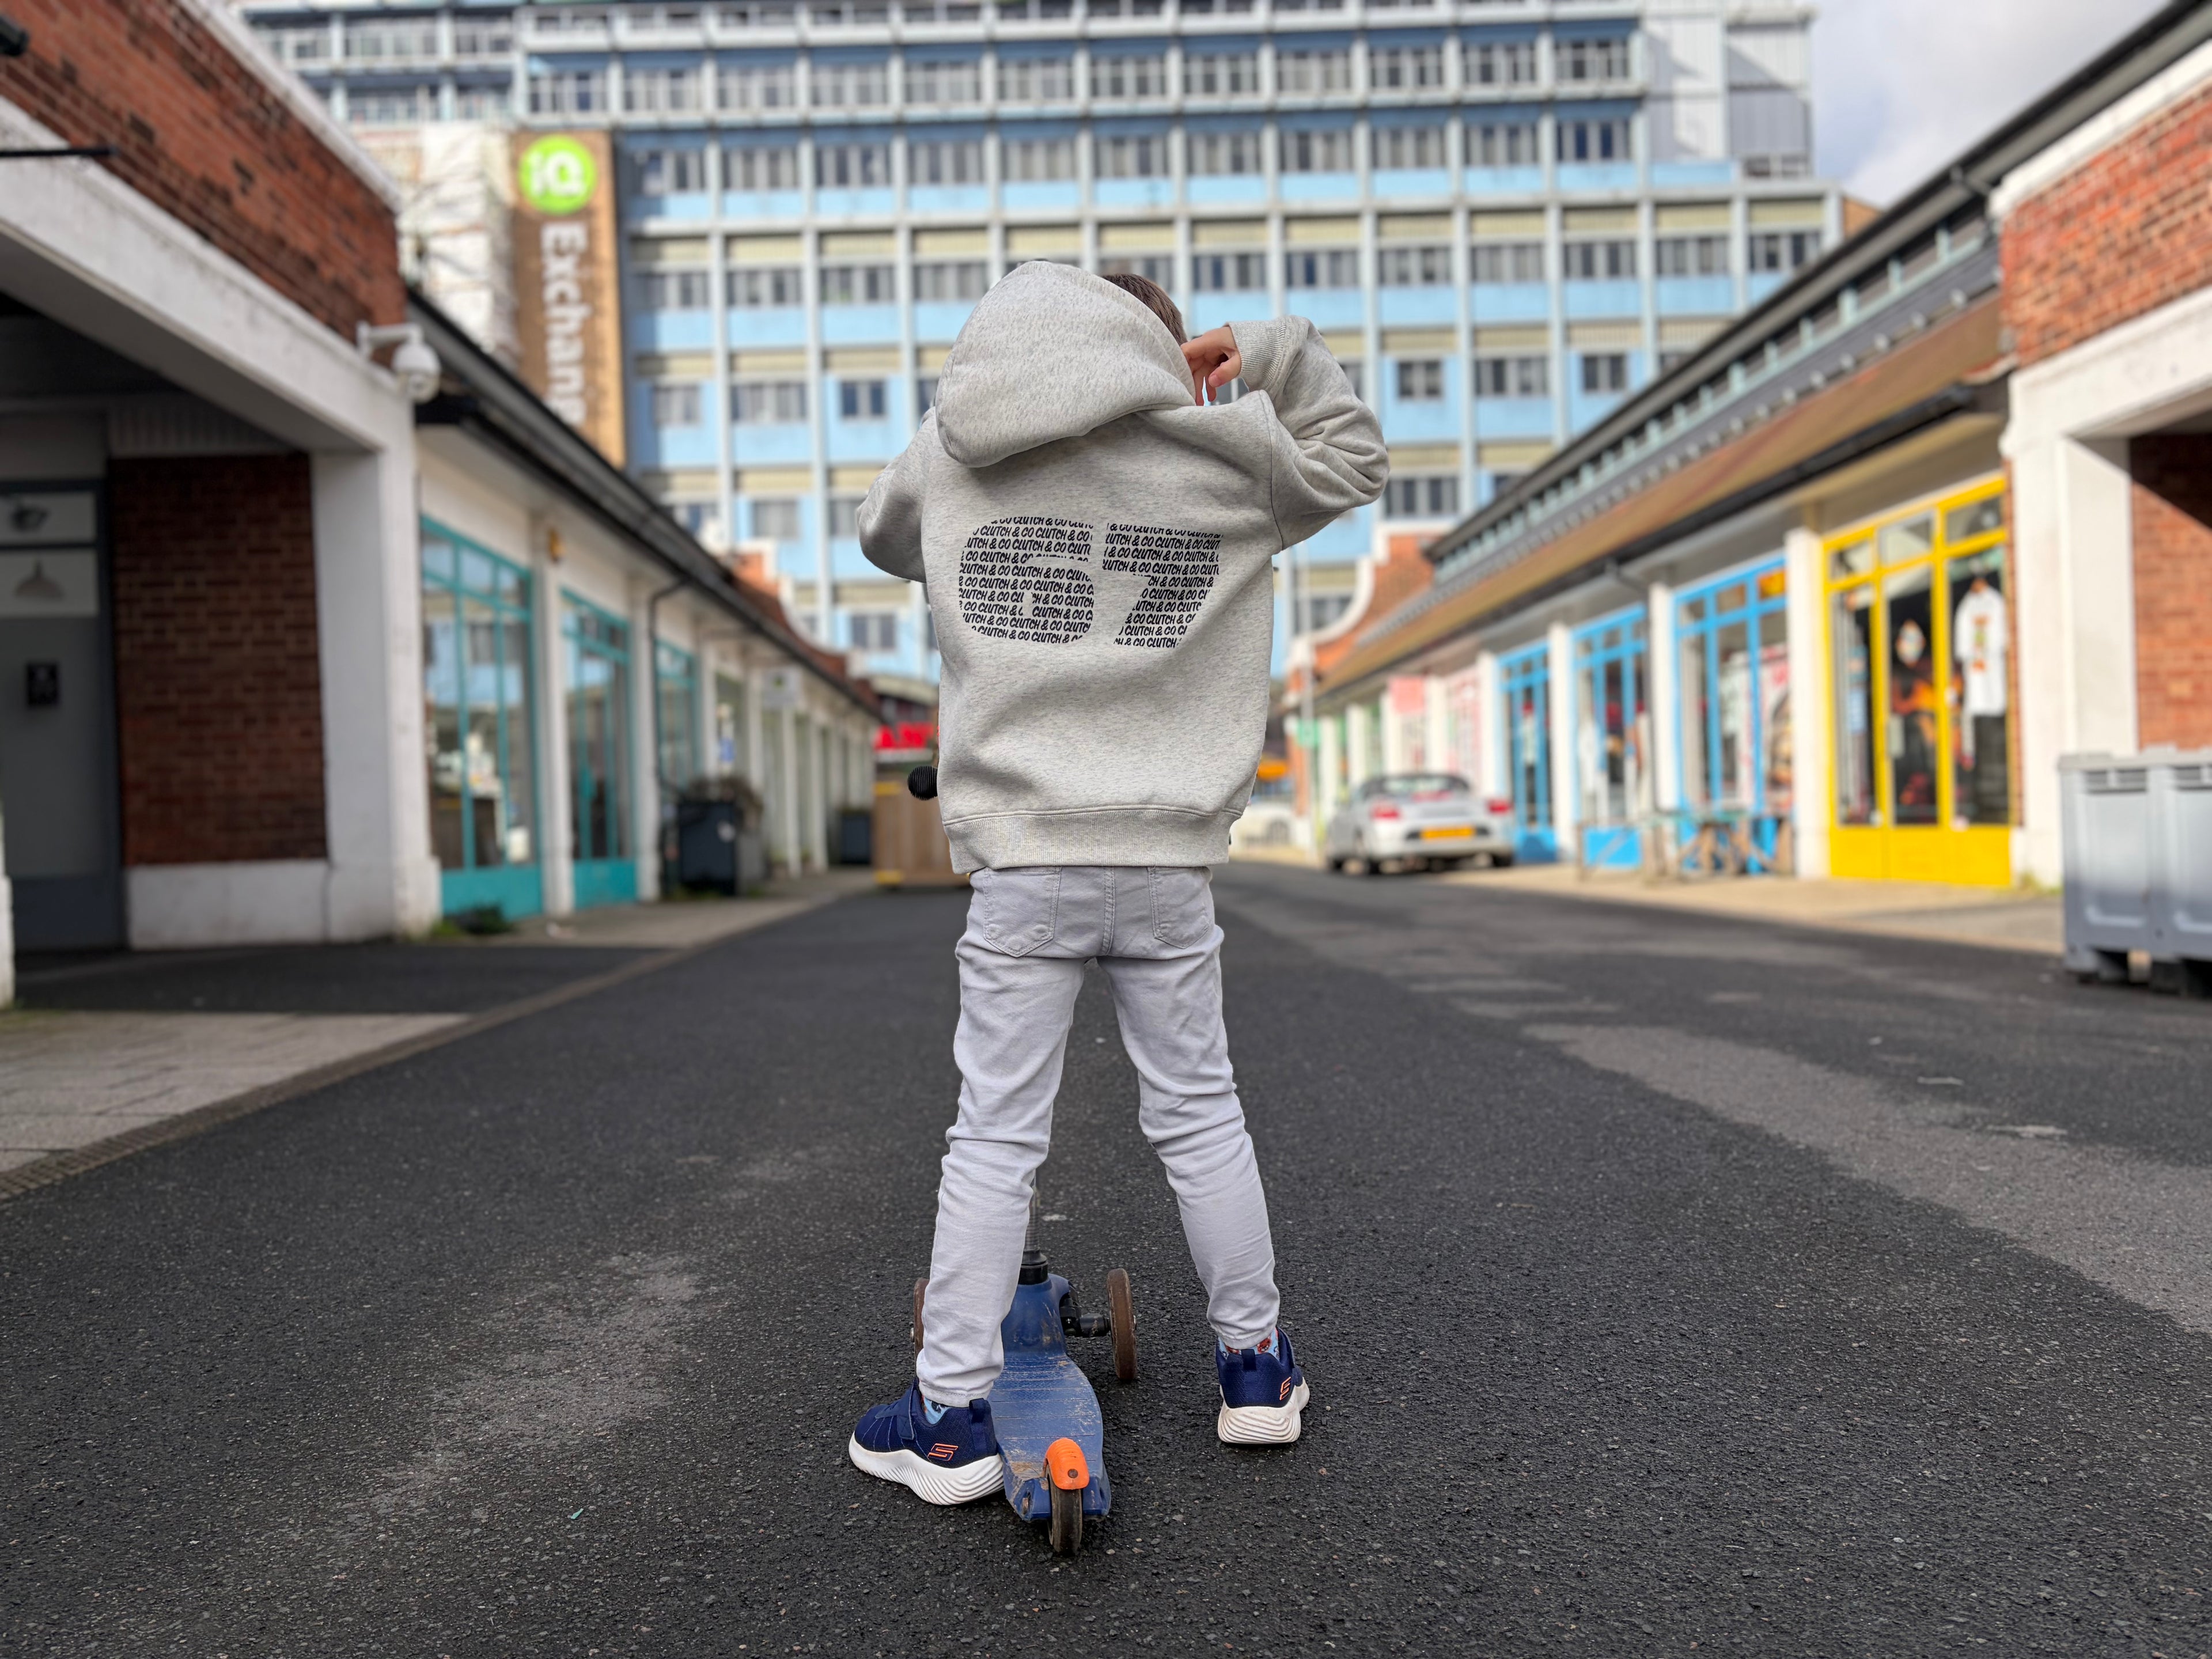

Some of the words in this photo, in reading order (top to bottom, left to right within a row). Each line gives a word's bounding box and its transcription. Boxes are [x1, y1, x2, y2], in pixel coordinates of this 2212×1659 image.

[980, 525, 1013, 537] CLUTCH
[1012, 526, 1020, 538] &
[1021, 527, 1035, 538] CO
[1035, 527, 1068, 541] CLUTCH
[1067, 529, 1076, 541] &
[1076, 530, 1090, 543] CO
[1105, 532, 1132, 546] LUTCH
[1131, 535, 1141, 547] &
[1141, 535, 1154, 547] CO
[1154, 536, 1186, 550] CLUTCH
[1184, 538, 1192, 550] &
[1191, 539, 1204, 550] CO
[964, 537, 990, 550] UTCH
[988, 537, 997, 550] &
[998, 538, 1012, 550] CO
[1012, 538, 1045, 552] CLUTCH
[1044, 540, 1053, 552] &
[1053, 541, 1067, 554] CO
[965, 550, 979, 562] CO
[979, 551, 1012, 564] CLUTCH
[1010, 552, 1020, 565] &
[1108, 546, 1117, 558] &
[1117, 547, 1131, 559] CO
[1131, 547, 1164, 562] CLUTCH
[1162, 550, 1171, 562] &
[1171, 550, 1184, 562] CO
[1184, 550, 1210, 563] CLUTCH
[1208, 551, 1215, 563] &
[988, 564, 997, 576] &
[997, 565, 1011, 577] CO
[1011, 565, 1044, 579] CLUTCH
[1043, 567, 1052, 579] &
[1052, 567, 1066, 580] CO
[1102, 559, 1130, 572] LUTCH
[1128, 560, 1138, 573] &
[1138, 562, 1152, 573] CO
[1152, 562, 1183, 575] CLUTCH
[1181, 563, 1190, 576] &
[1189, 564, 1200, 575] CO
[964, 576, 978, 588] CO
[979, 577, 1011, 590] CLUTCH
[1010, 578, 1018, 590] &
[1019, 579, 1033, 591] CO
[1033, 579, 1065, 593] CLUTCH
[1064, 582, 1073, 594] &
[1073, 583, 1086, 595] CO
[1159, 575, 1168, 588] &
[1168, 576, 1181, 588] CO
[1180, 576, 1207, 588] CLUTCH
[1206, 576, 1214, 588] &
[987, 590, 996, 602] &
[997, 591, 1010, 603] CO
[1041, 593, 1051, 605] &
[1051, 594, 1064, 606] CO
[1064, 594, 1094, 609] CLUTCH
[1149, 588, 1179, 601] CLUTCH
[1177, 589, 1185, 601] &
[1185, 589, 1198, 600] CO
[964, 601, 978, 612] CO
[978, 602, 1010, 616] CLUTCH
[1009, 604, 1018, 616] &
[1032, 605, 1064, 619] CLUTCH
[1063, 608, 1071, 620] &
[1071, 609, 1085, 620] CO
[1131, 600, 1157, 612] UTCH
[1155, 601, 1164, 613] &
[1164, 601, 1177, 613] CO
[986, 615, 995, 626] &
[995, 616, 1009, 627] CO
[1009, 616, 1041, 630] CLUTCH
[1040, 619, 1049, 631] &
[1049, 620, 1063, 632] CO
[1132, 613, 1146, 624] CO
[1146, 613, 1176, 625] CLUTCH
[1176, 613, 1184, 624] &
[1008, 629, 1017, 640] &
[1017, 630, 1031, 641] CO
[1031, 631, 1063, 644] CLUTCH
[1124, 624, 1155, 637] CLUTCH
[1155, 626, 1162, 636] &
[1164, 625, 1177, 635] CO
[1146, 637, 1177, 649] CLUTCH
